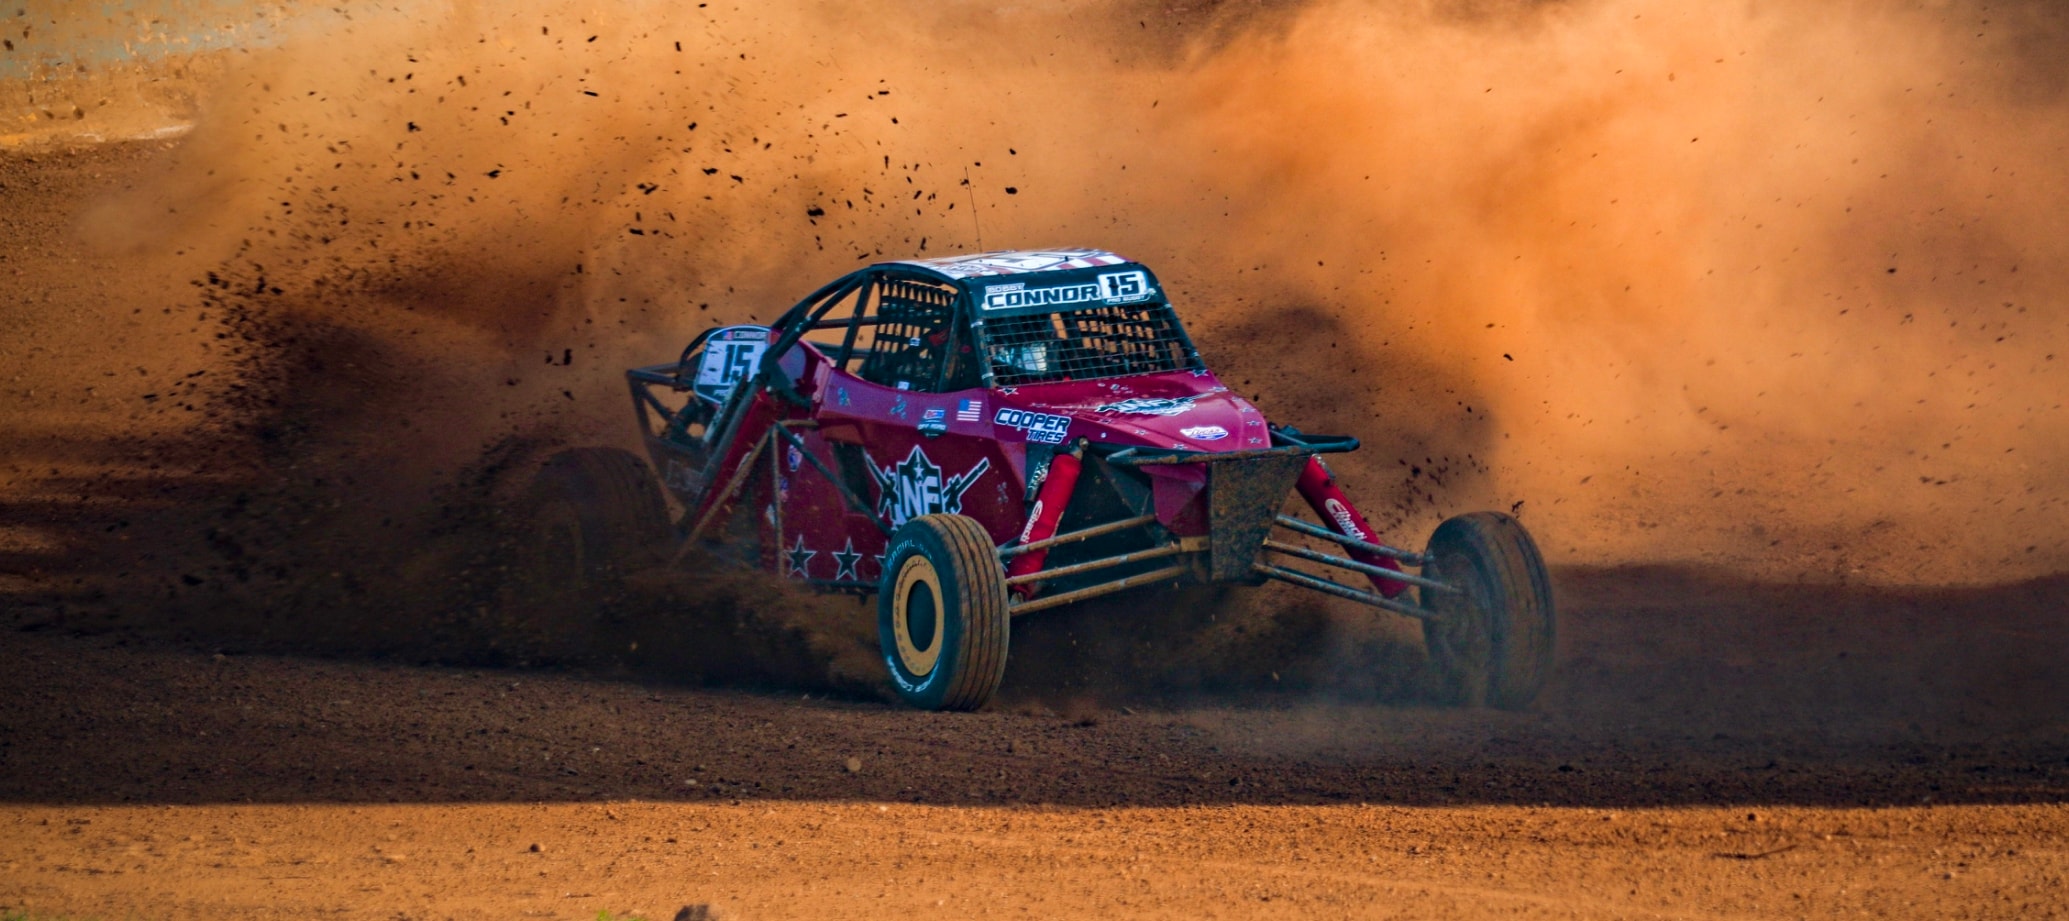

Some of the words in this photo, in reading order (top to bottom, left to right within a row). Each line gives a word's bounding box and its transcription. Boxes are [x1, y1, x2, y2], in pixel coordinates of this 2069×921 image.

[986, 285, 1099, 309] CONNOR
[1106, 273, 1140, 297] 15
[720, 344, 755, 384] 15
[995, 408, 1071, 432] COOPER
[1027, 428, 1067, 444] TIRES
